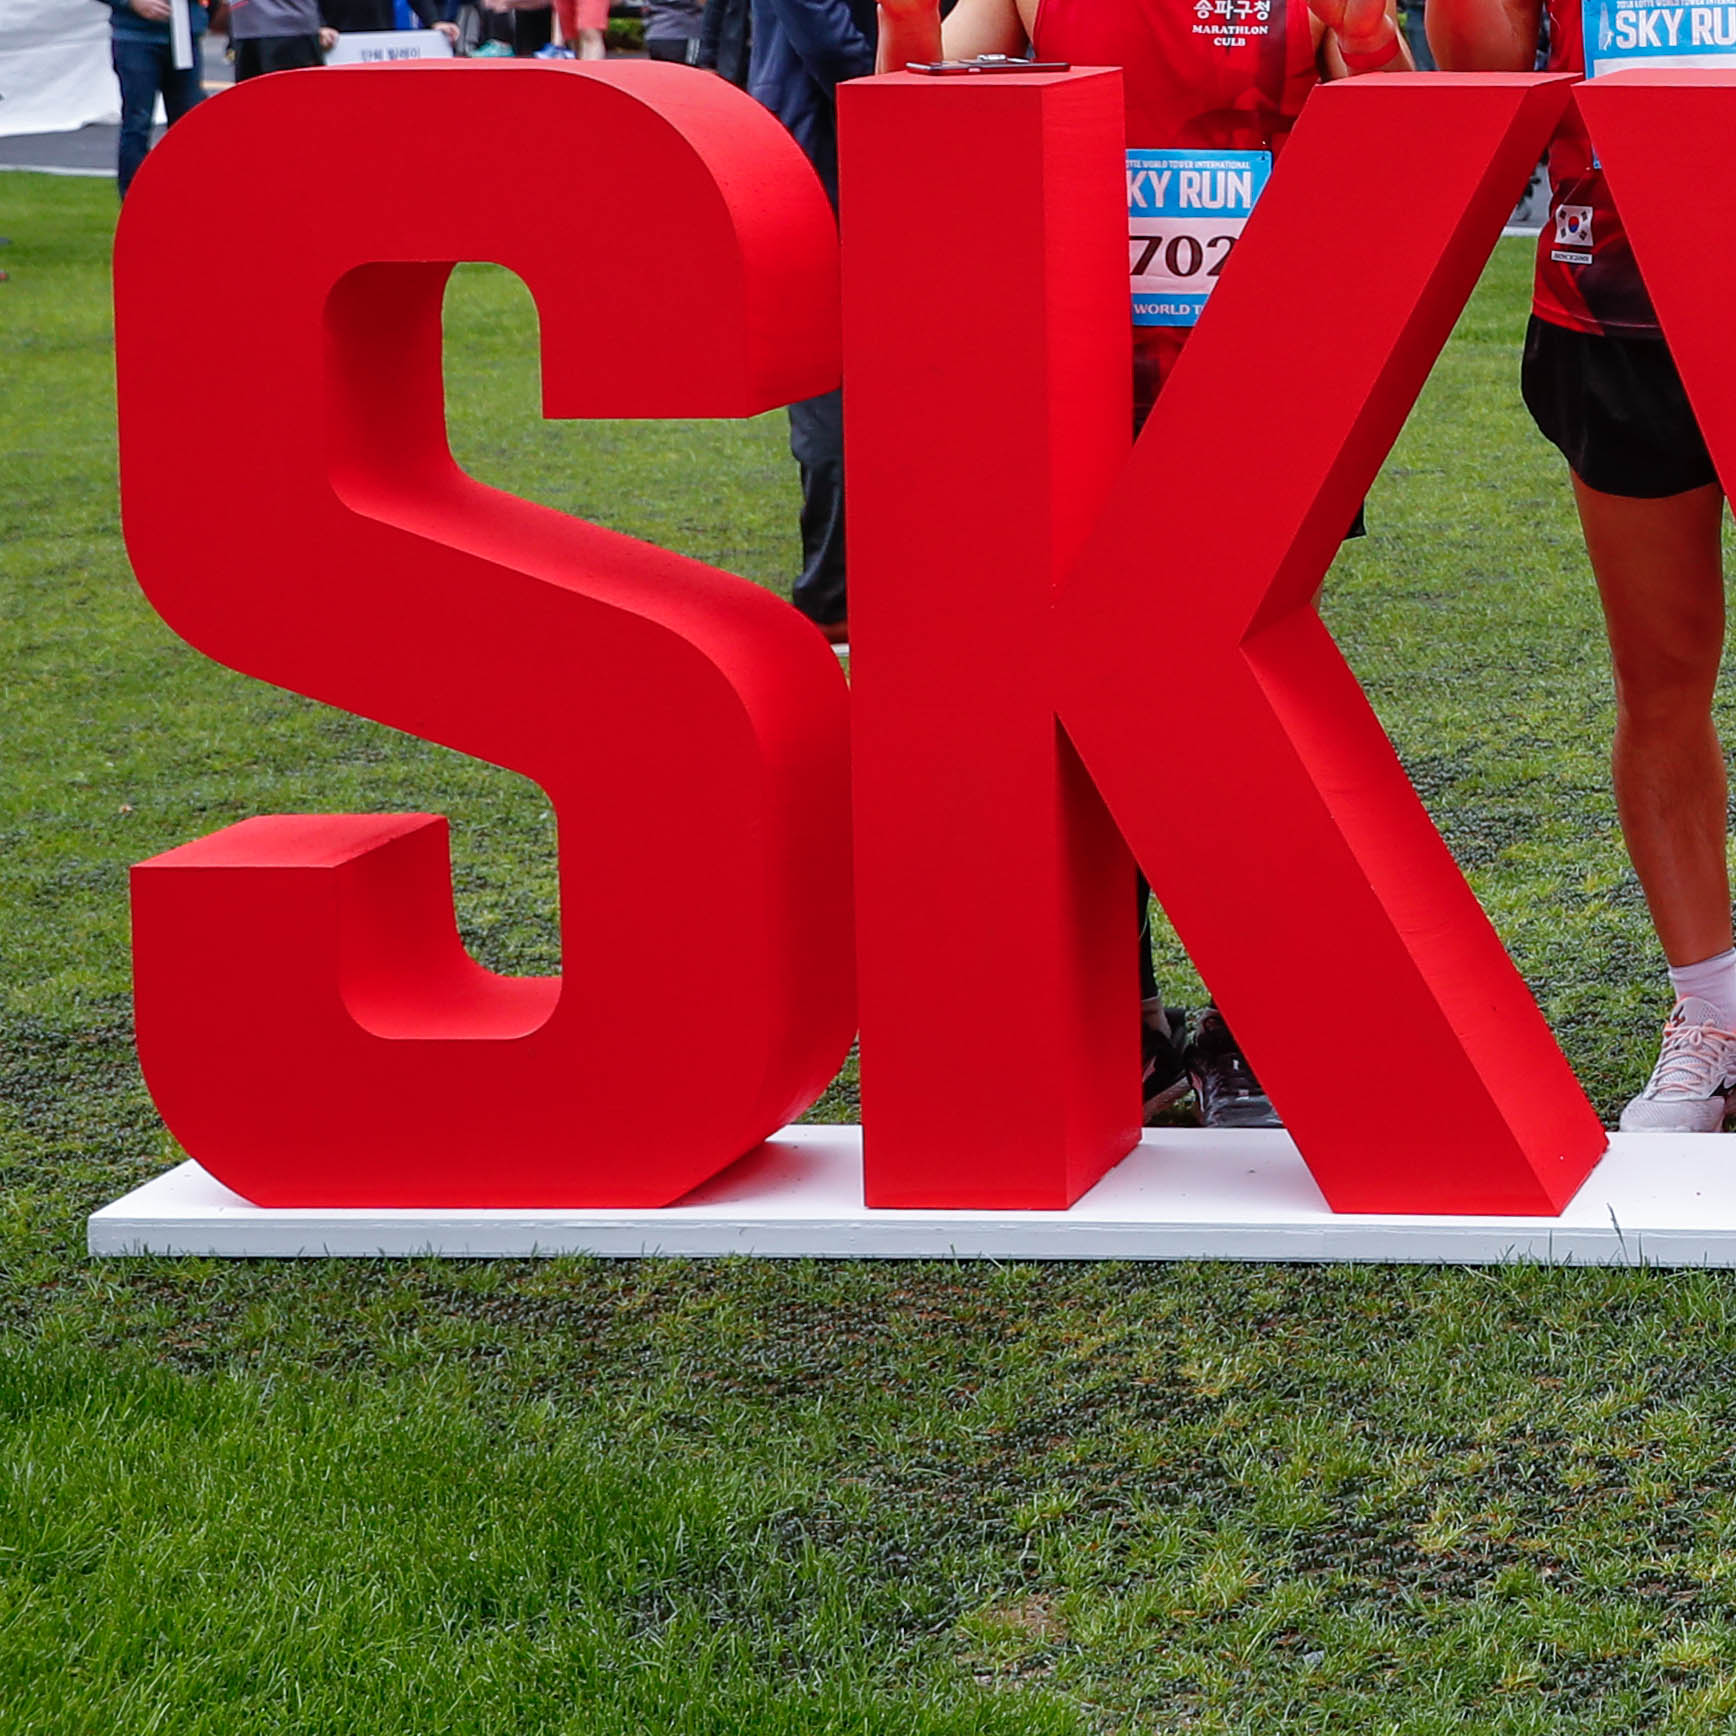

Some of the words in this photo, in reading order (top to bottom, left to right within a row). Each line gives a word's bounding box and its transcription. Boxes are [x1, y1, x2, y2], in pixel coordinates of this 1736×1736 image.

[1192, 24, 1269, 35] MARATHLON
[1213, 37, 1246, 46] CULB
[1615, 8, 1684, 50] SKY
[1126, 170, 1172, 208] KY
[1179, 170, 1252, 209] RUN
[1129, 235, 1238, 277] 702
[1134, 303, 1190, 315] WORLD
